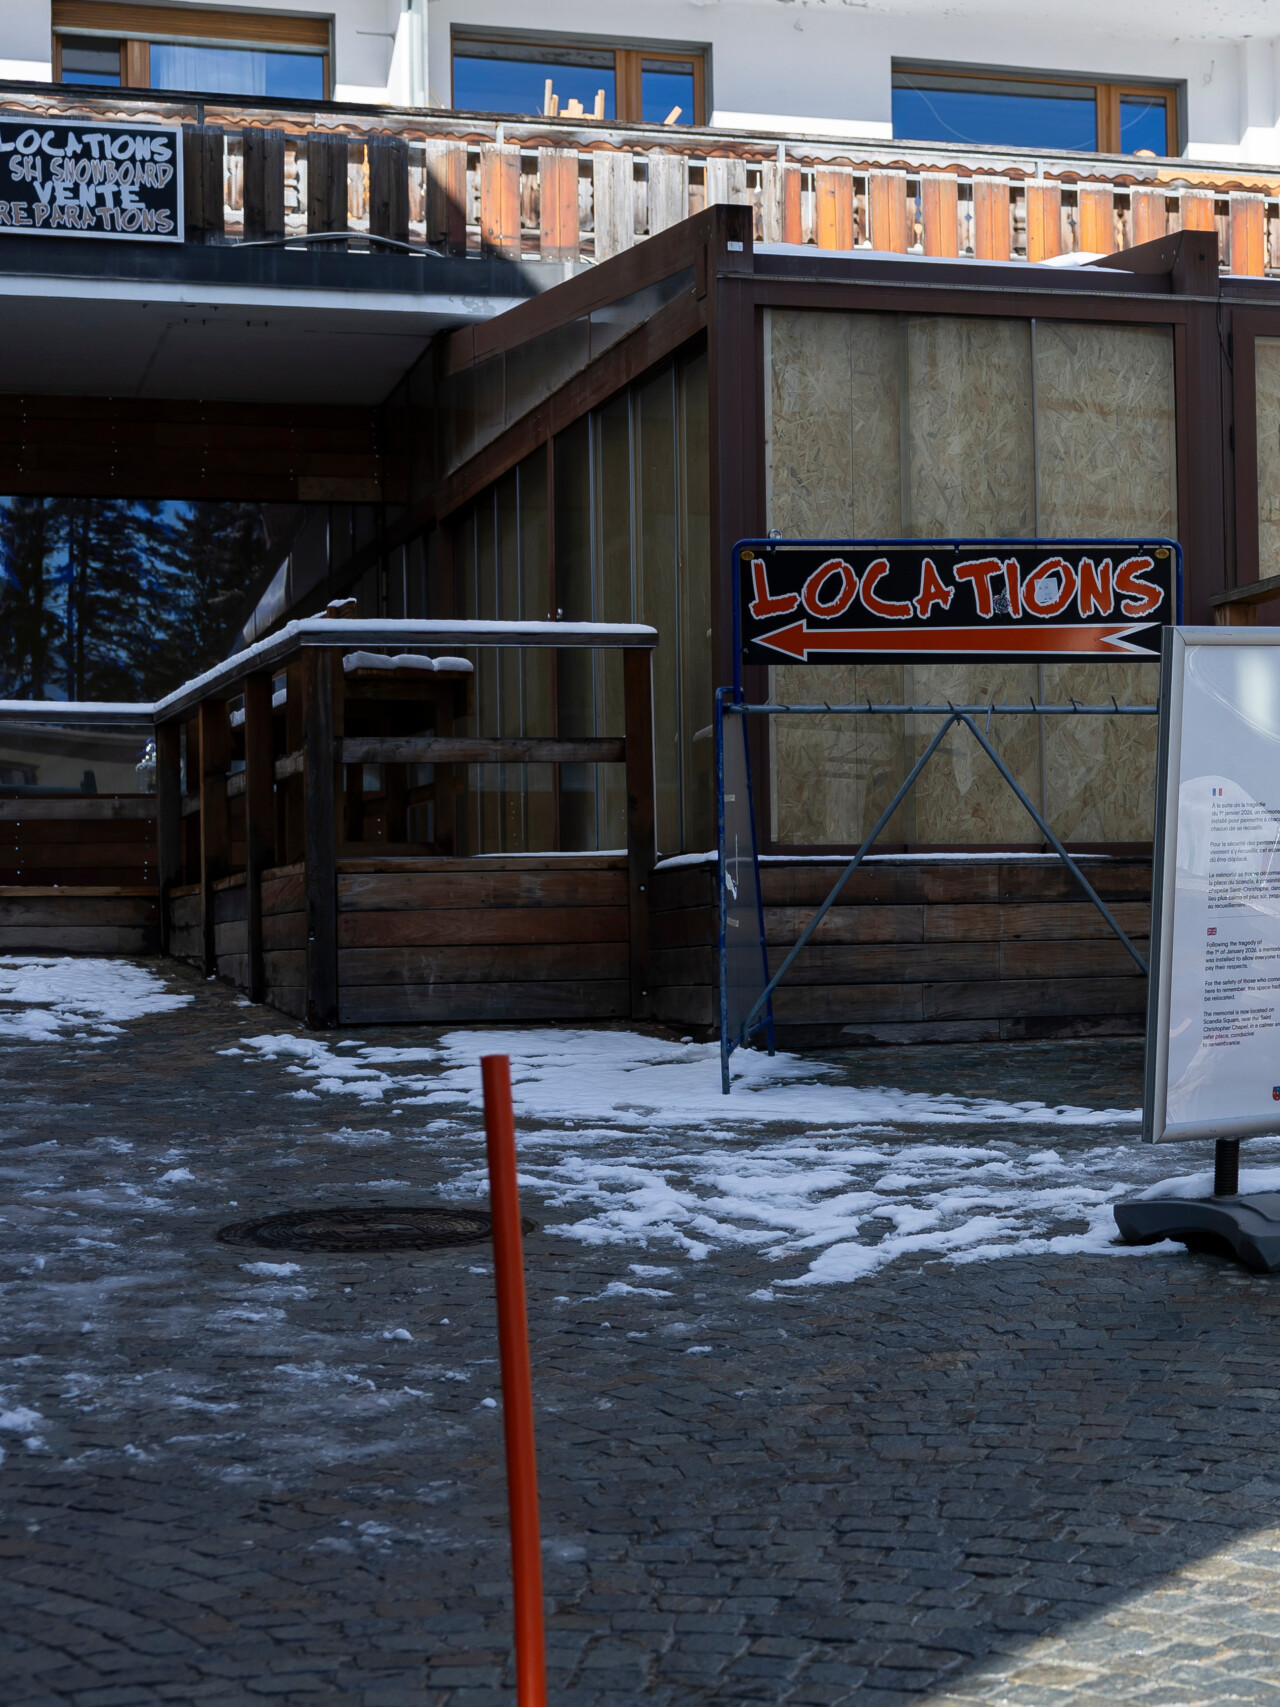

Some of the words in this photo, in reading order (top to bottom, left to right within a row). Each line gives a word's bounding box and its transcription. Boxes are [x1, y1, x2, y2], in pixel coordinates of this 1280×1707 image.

[50, 156, 174, 189] SNOWBOARD
[33, 180, 146, 210] VENTE
[749, 557, 1164, 618] LOCATIONS
[1206, 941, 1229, 949] Following
[1238, 939, 1256, 947] tragedy
[1227, 947, 1245, 956] January
[1215, 955, 1236, 963] installed
[1222, 978, 1237, 987] safety
[1203, 1017, 1223, 1025] Scandia
[1203, 1024, 1231, 1034] Christopher
[1215, 1032, 1230, 1041] place,
[1230, 1030, 1255, 1038] conducive
